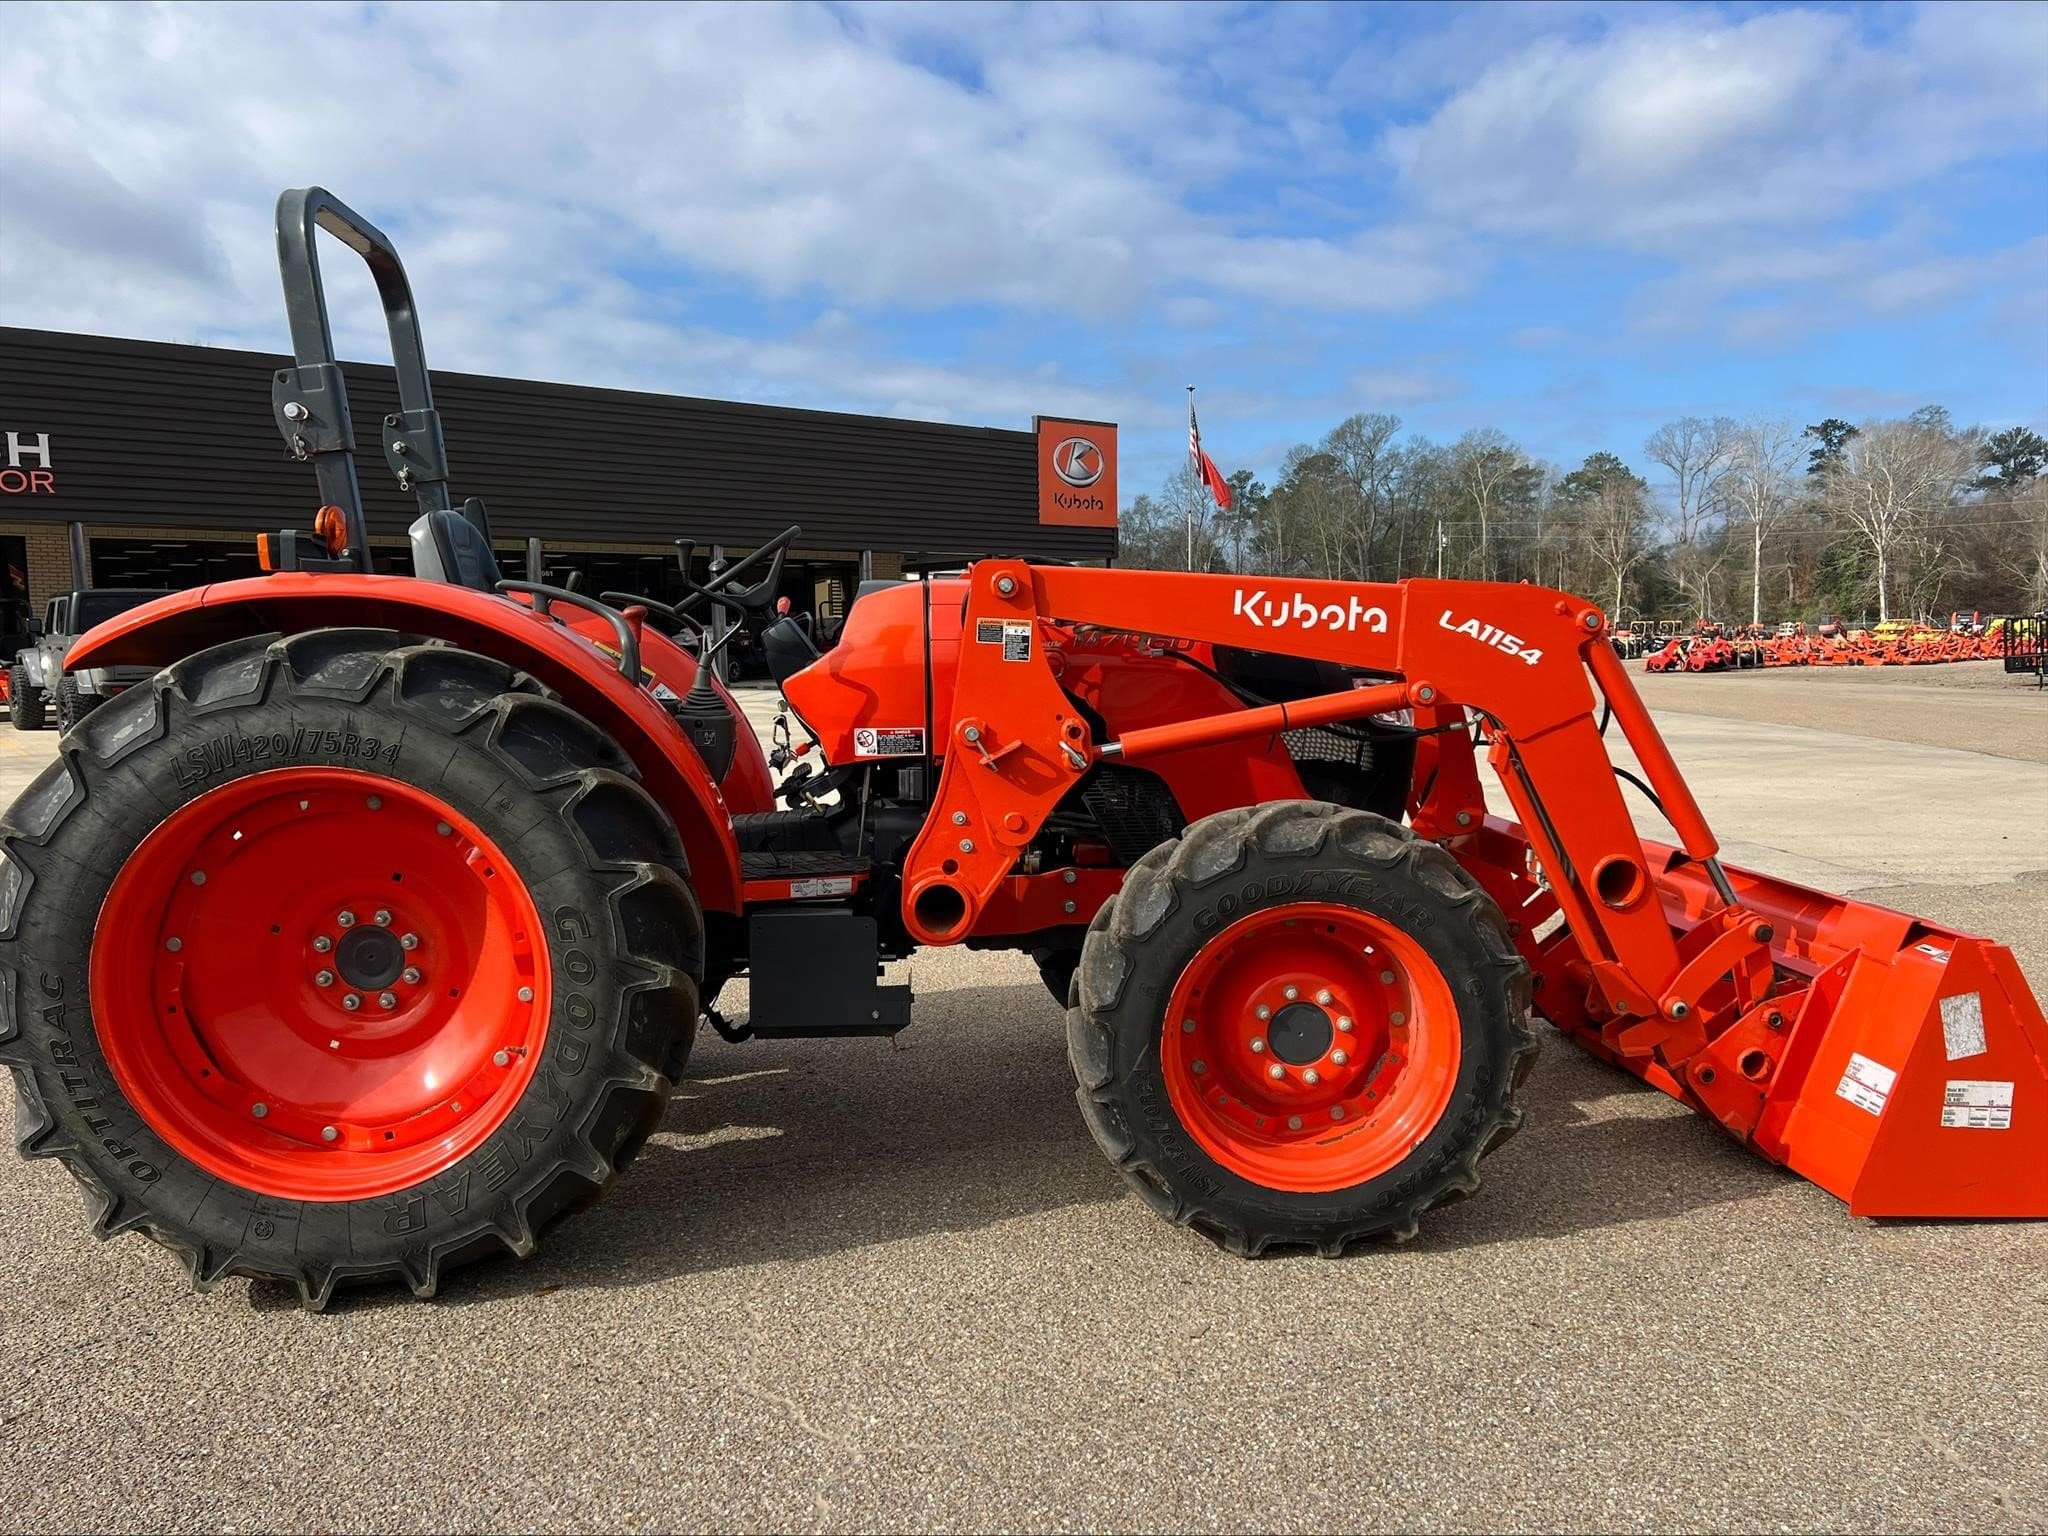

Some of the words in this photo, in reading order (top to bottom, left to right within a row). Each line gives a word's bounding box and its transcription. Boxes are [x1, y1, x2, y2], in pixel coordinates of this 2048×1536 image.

[0, 470, 56, 494] OR
[1054, 492, 1104, 511] Kubota
[1233, 589, 1388, 634] Kubota
[1439, 609, 1544, 666] LA1154
[169, 728, 402, 789] LSW420/75R34
[1193, 870, 1436, 934] GOODYEAR
[40, 971, 162, 1184] OPTITRAC
[383, 905, 590, 1237] GOODYEAR
